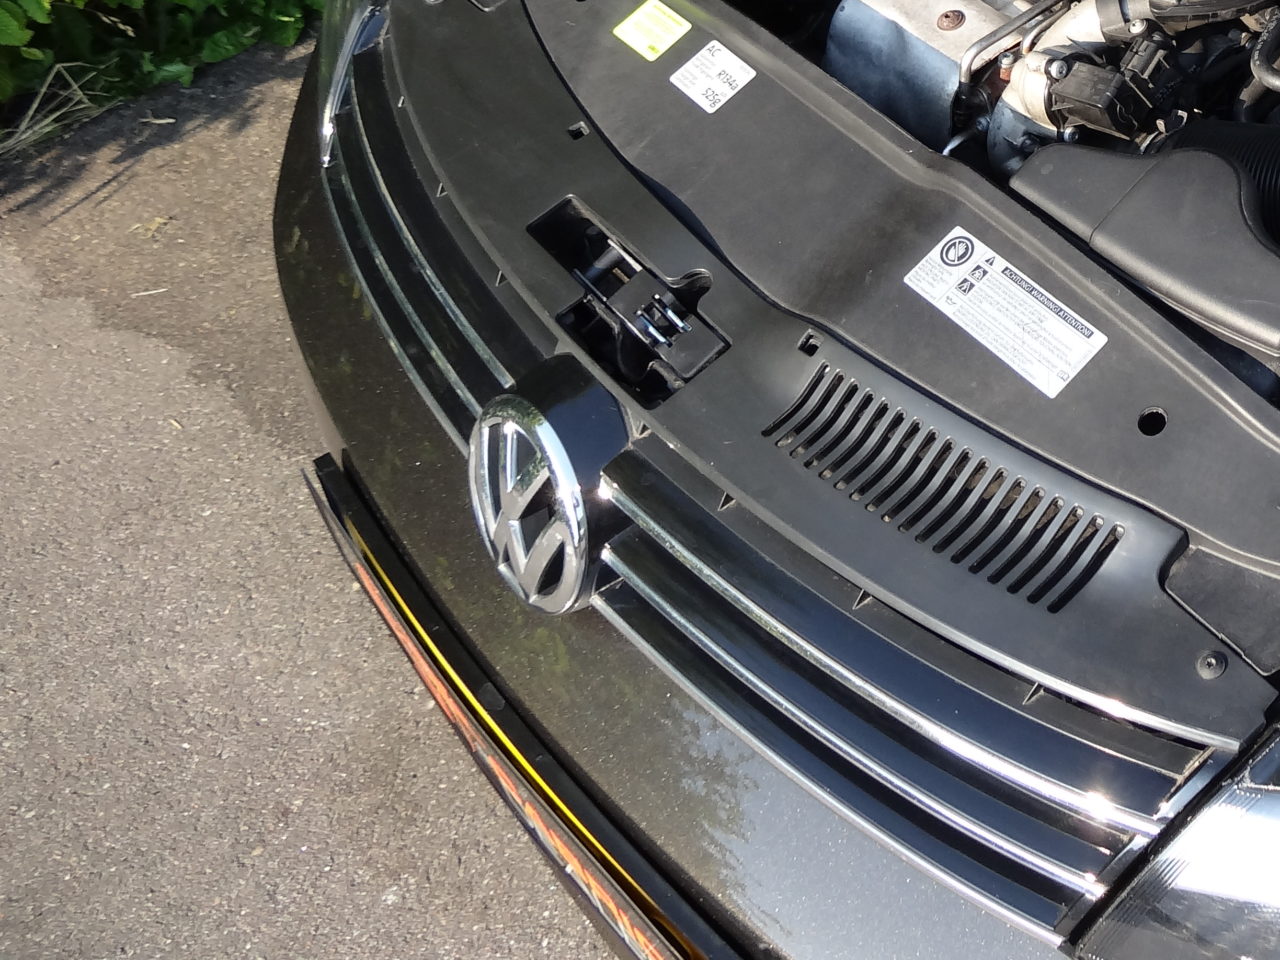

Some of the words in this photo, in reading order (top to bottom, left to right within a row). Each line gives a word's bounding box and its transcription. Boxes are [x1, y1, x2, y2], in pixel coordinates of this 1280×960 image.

[706, 45, 721, 57] AC
[716, 70, 738, 91] R134a
[701, 88, 721, 108] 525g
[1004, 269, 1033, 294] ACHTUNG!
[1031, 288, 1061, 316] WARNING!
[1058, 307, 1093, 338] ATTENTION!
